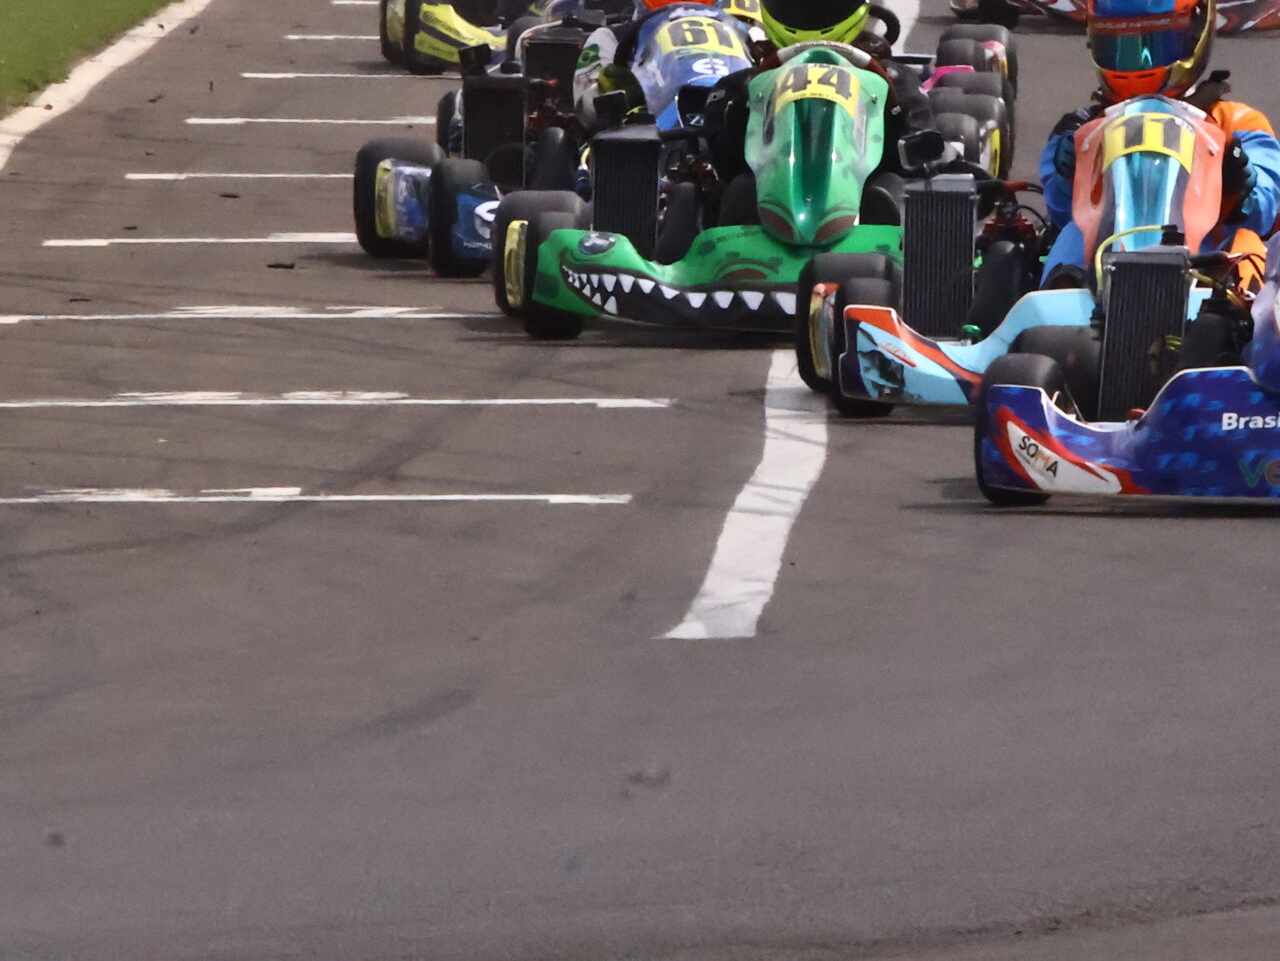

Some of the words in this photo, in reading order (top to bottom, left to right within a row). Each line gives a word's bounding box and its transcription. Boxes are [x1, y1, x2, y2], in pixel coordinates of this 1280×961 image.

[668, 20, 735, 49] 61
[779, 64, 853, 101] 44
[1111, 113, 1182, 153] 11
[1018, 435, 1058, 478] SOMA
